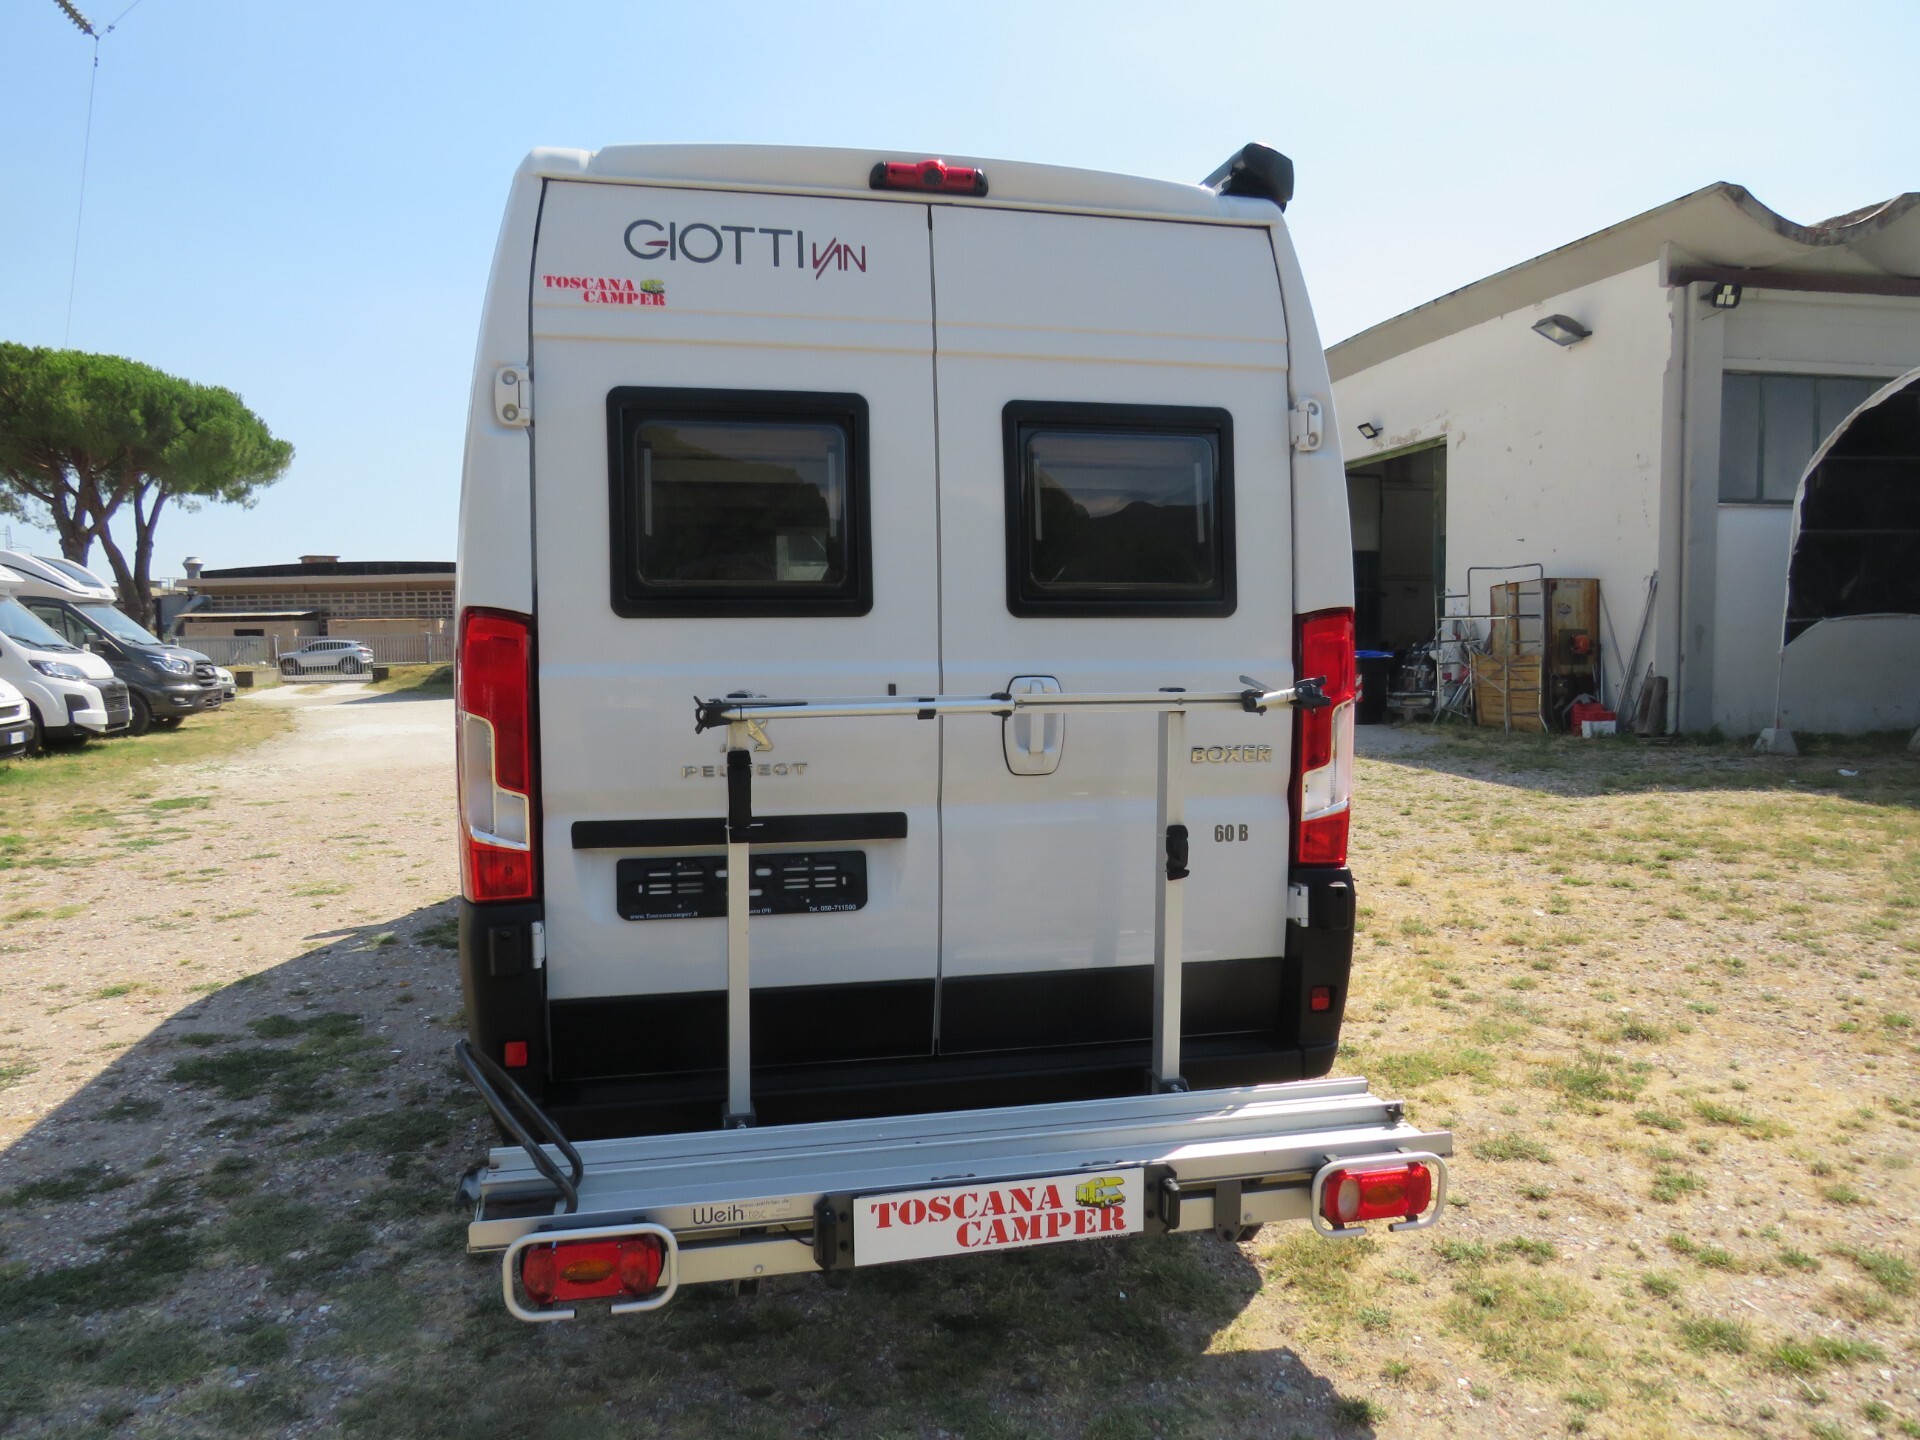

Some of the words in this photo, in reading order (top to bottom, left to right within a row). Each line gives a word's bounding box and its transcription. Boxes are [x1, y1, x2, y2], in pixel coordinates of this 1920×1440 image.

[543, 275, 635, 292] TOSCANA
[583, 289, 666, 307] CAMPER
[1190, 744, 1273, 764] BOXER
[1214, 824, 1235, 842] 60
[1238, 823, 1249, 842] B
[870, 1184, 1063, 1230] TOSCANA
[955, 1203, 1128, 1249] CAMPER
